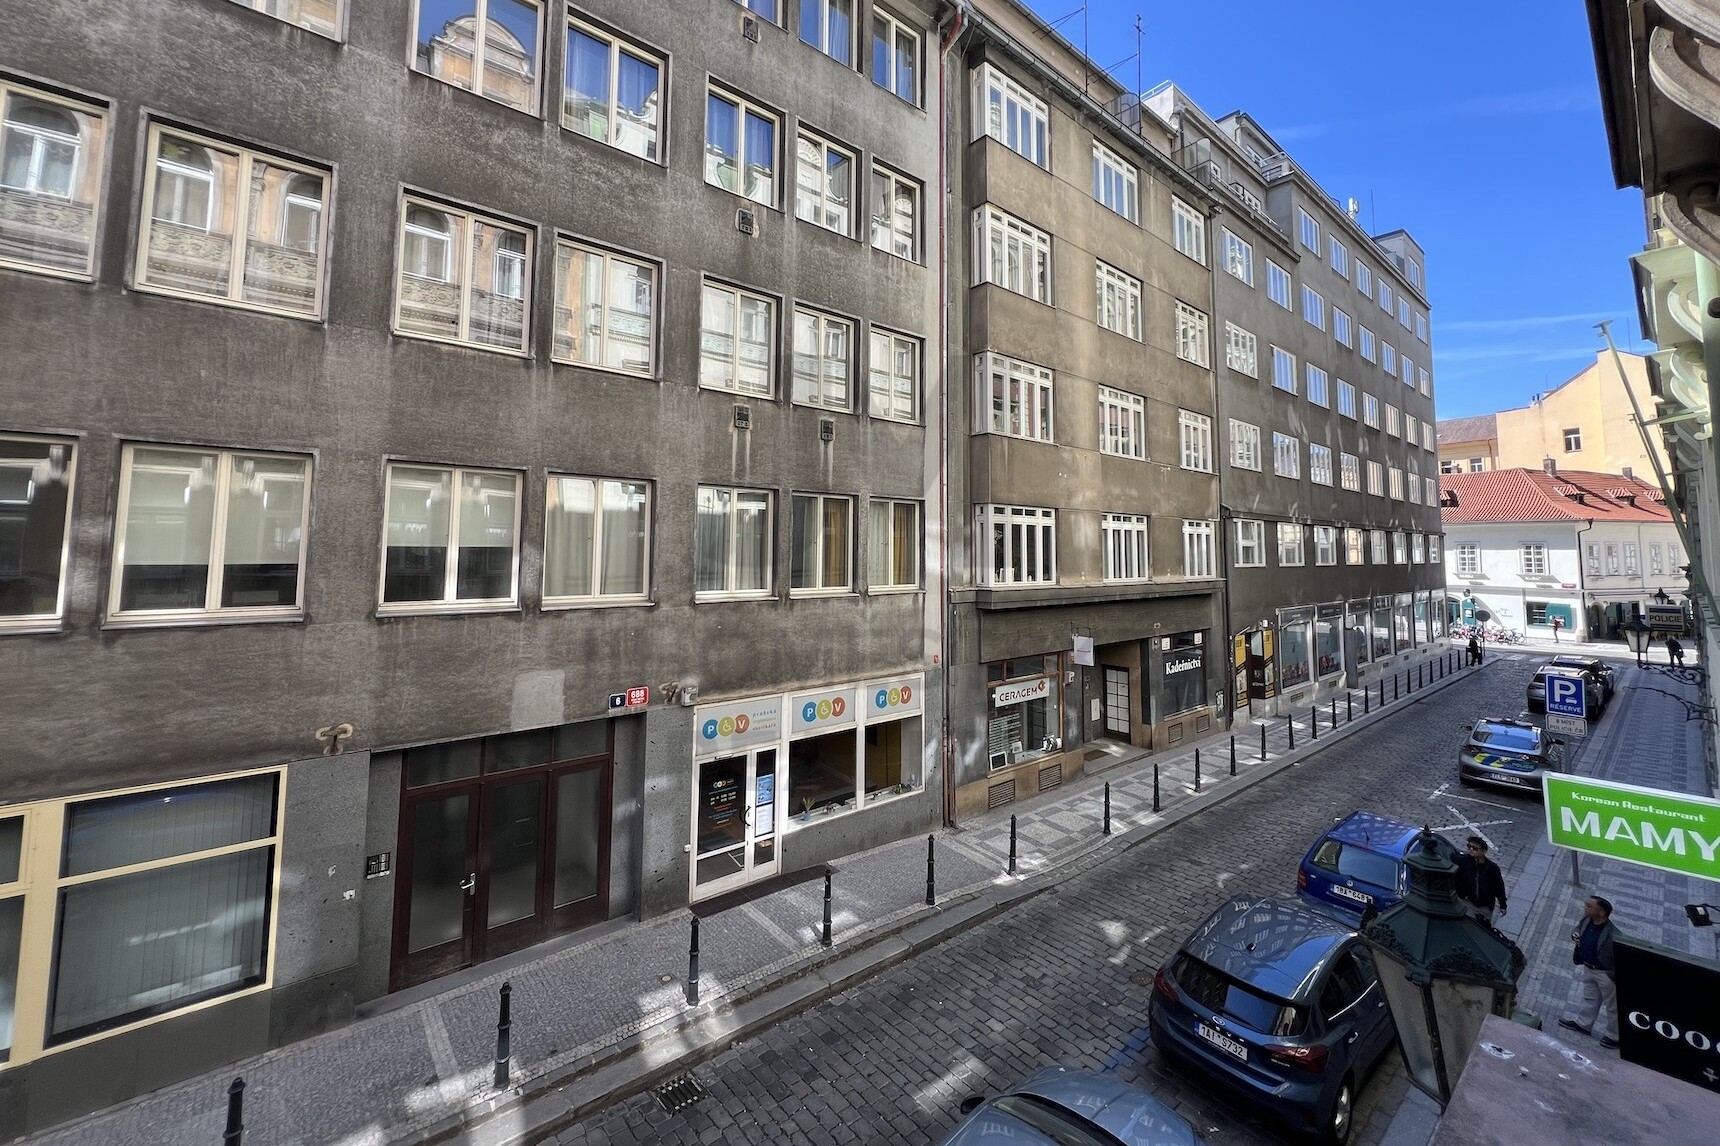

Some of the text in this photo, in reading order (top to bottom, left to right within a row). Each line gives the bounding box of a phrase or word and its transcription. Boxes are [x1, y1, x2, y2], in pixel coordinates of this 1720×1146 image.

[1649, 614, 1682, 623] POLICIE
[615, 696, 621, 706] 6
[630, 689, 645, 699] 688
[999, 686, 1038, 702] CERAGEM
[1553, 679, 1577, 703] P
[1571, 791, 1707, 823] Korean Restaurant
[1560, 806, 1720, 862] MAMY
[1628, 1011, 1720, 1054] COO
